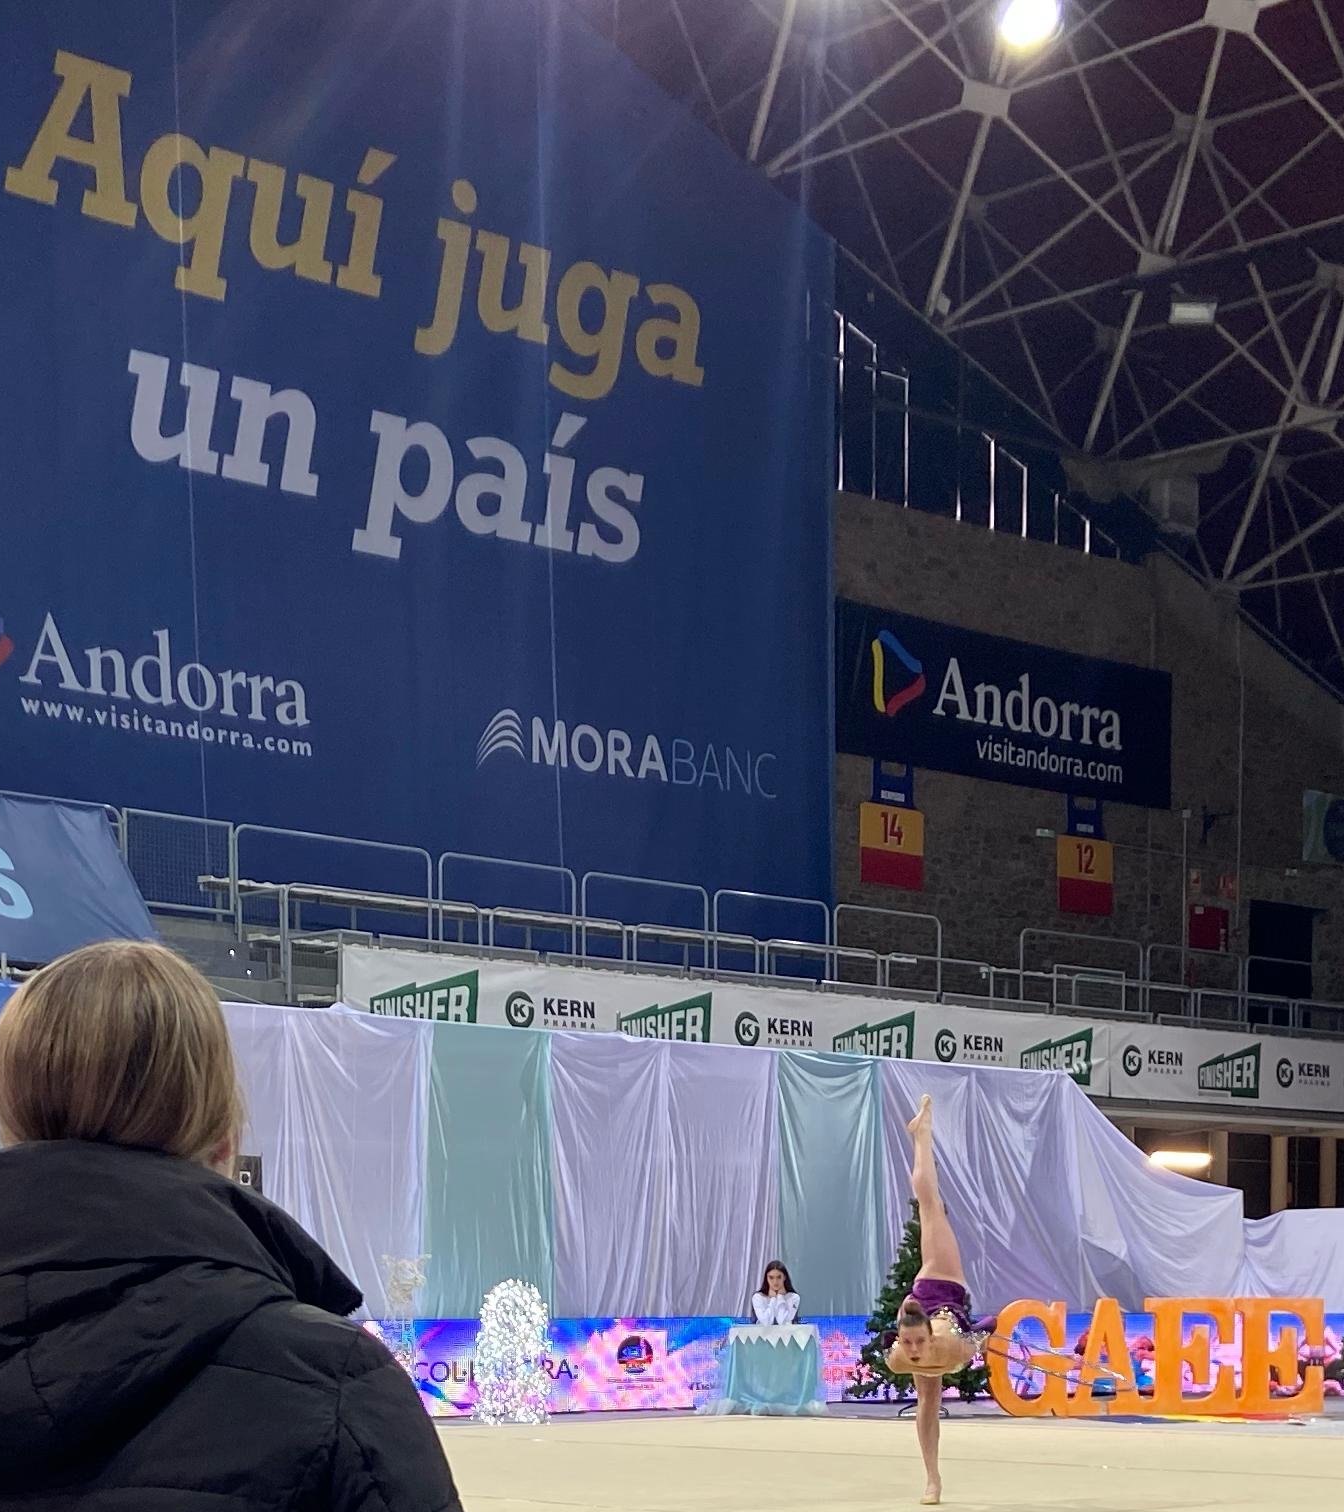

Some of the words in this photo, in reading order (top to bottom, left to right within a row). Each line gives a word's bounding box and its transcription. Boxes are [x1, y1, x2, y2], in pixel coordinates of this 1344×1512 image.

[4, 49, 397, 301] Aquí
[414, 178, 704, 399] juga
[128, 349, 318, 497] un
[351, 409, 645, 564] país
[19, 611, 311, 727] Andorra
[932, 657, 1122, 750] Andorra
[21, 697, 313, 757] www.visitandorra.com
[976, 735, 1123, 783] visitandorra.com
[880, 811, 904, 846] 14
[1076, 843, 1095, 875] 12
[543, 997, 596, 1019] KERN
[767, 1017, 813, 1038] KERN
[963, 1034, 1003, 1053] KERN
[1148, 1050, 1183, 1067] KERN
[1199, 1054, 1256, 1089] FINISHER
[1298, 1063, 1330, 1078] KERN
[984, 1297, 1324, 1417] GAEE
